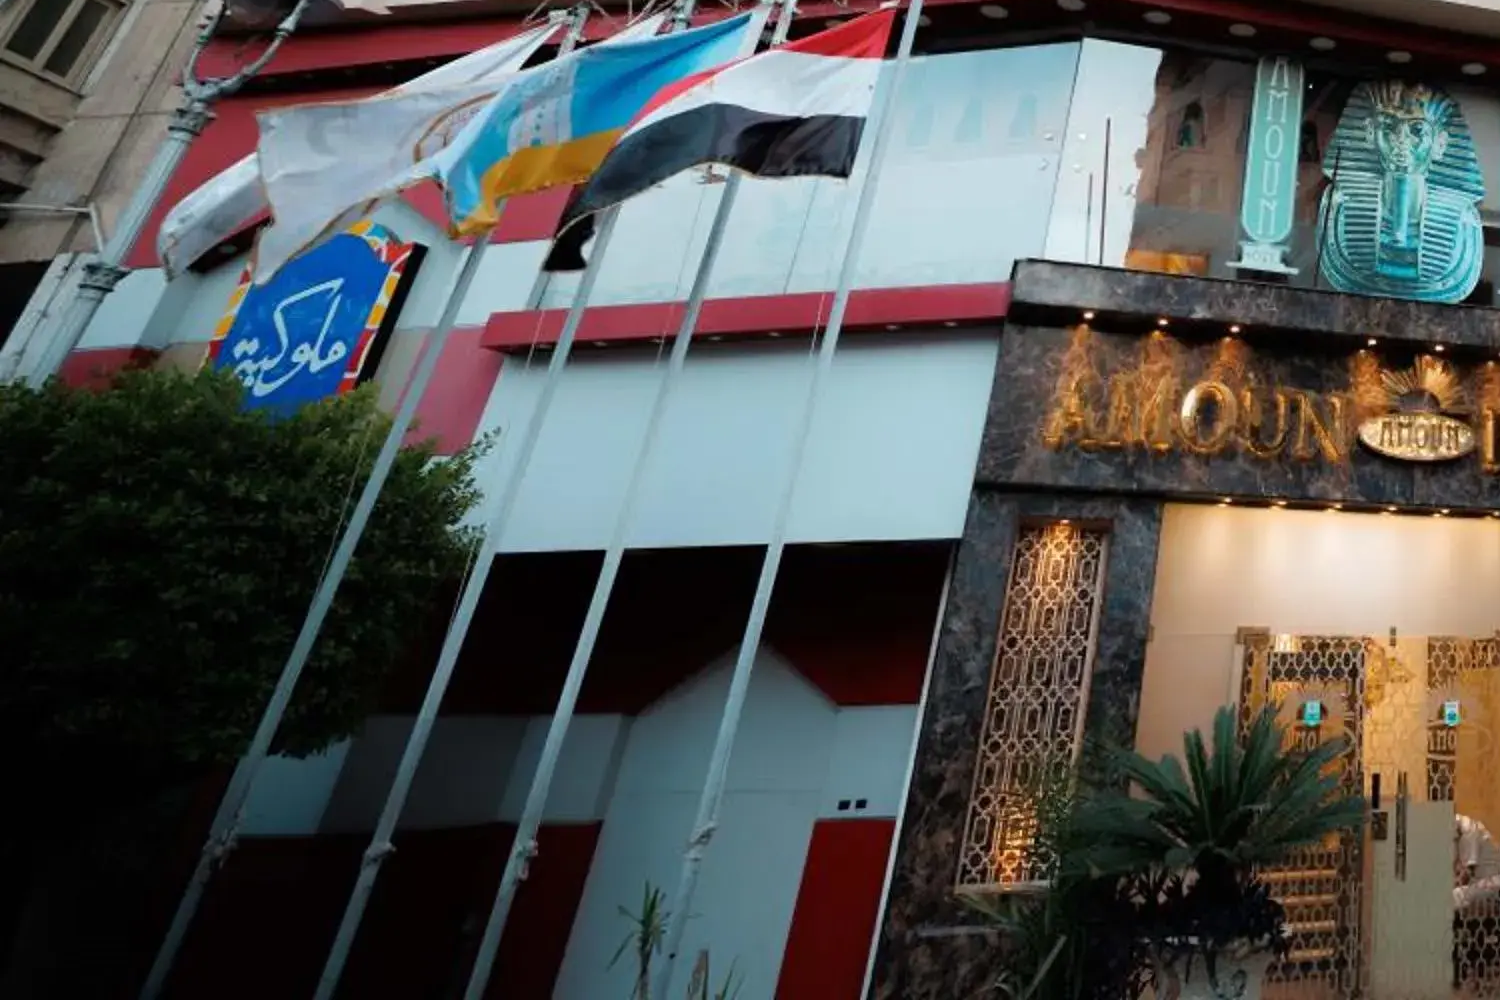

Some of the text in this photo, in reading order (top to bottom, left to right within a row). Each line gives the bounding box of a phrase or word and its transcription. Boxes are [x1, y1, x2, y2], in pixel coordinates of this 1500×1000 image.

[1258, 56, 1290, 236] AMOUN
[1043, 372, 1347, 462] AMOUN
[1380, 420, 1460, 451] AMOUN
